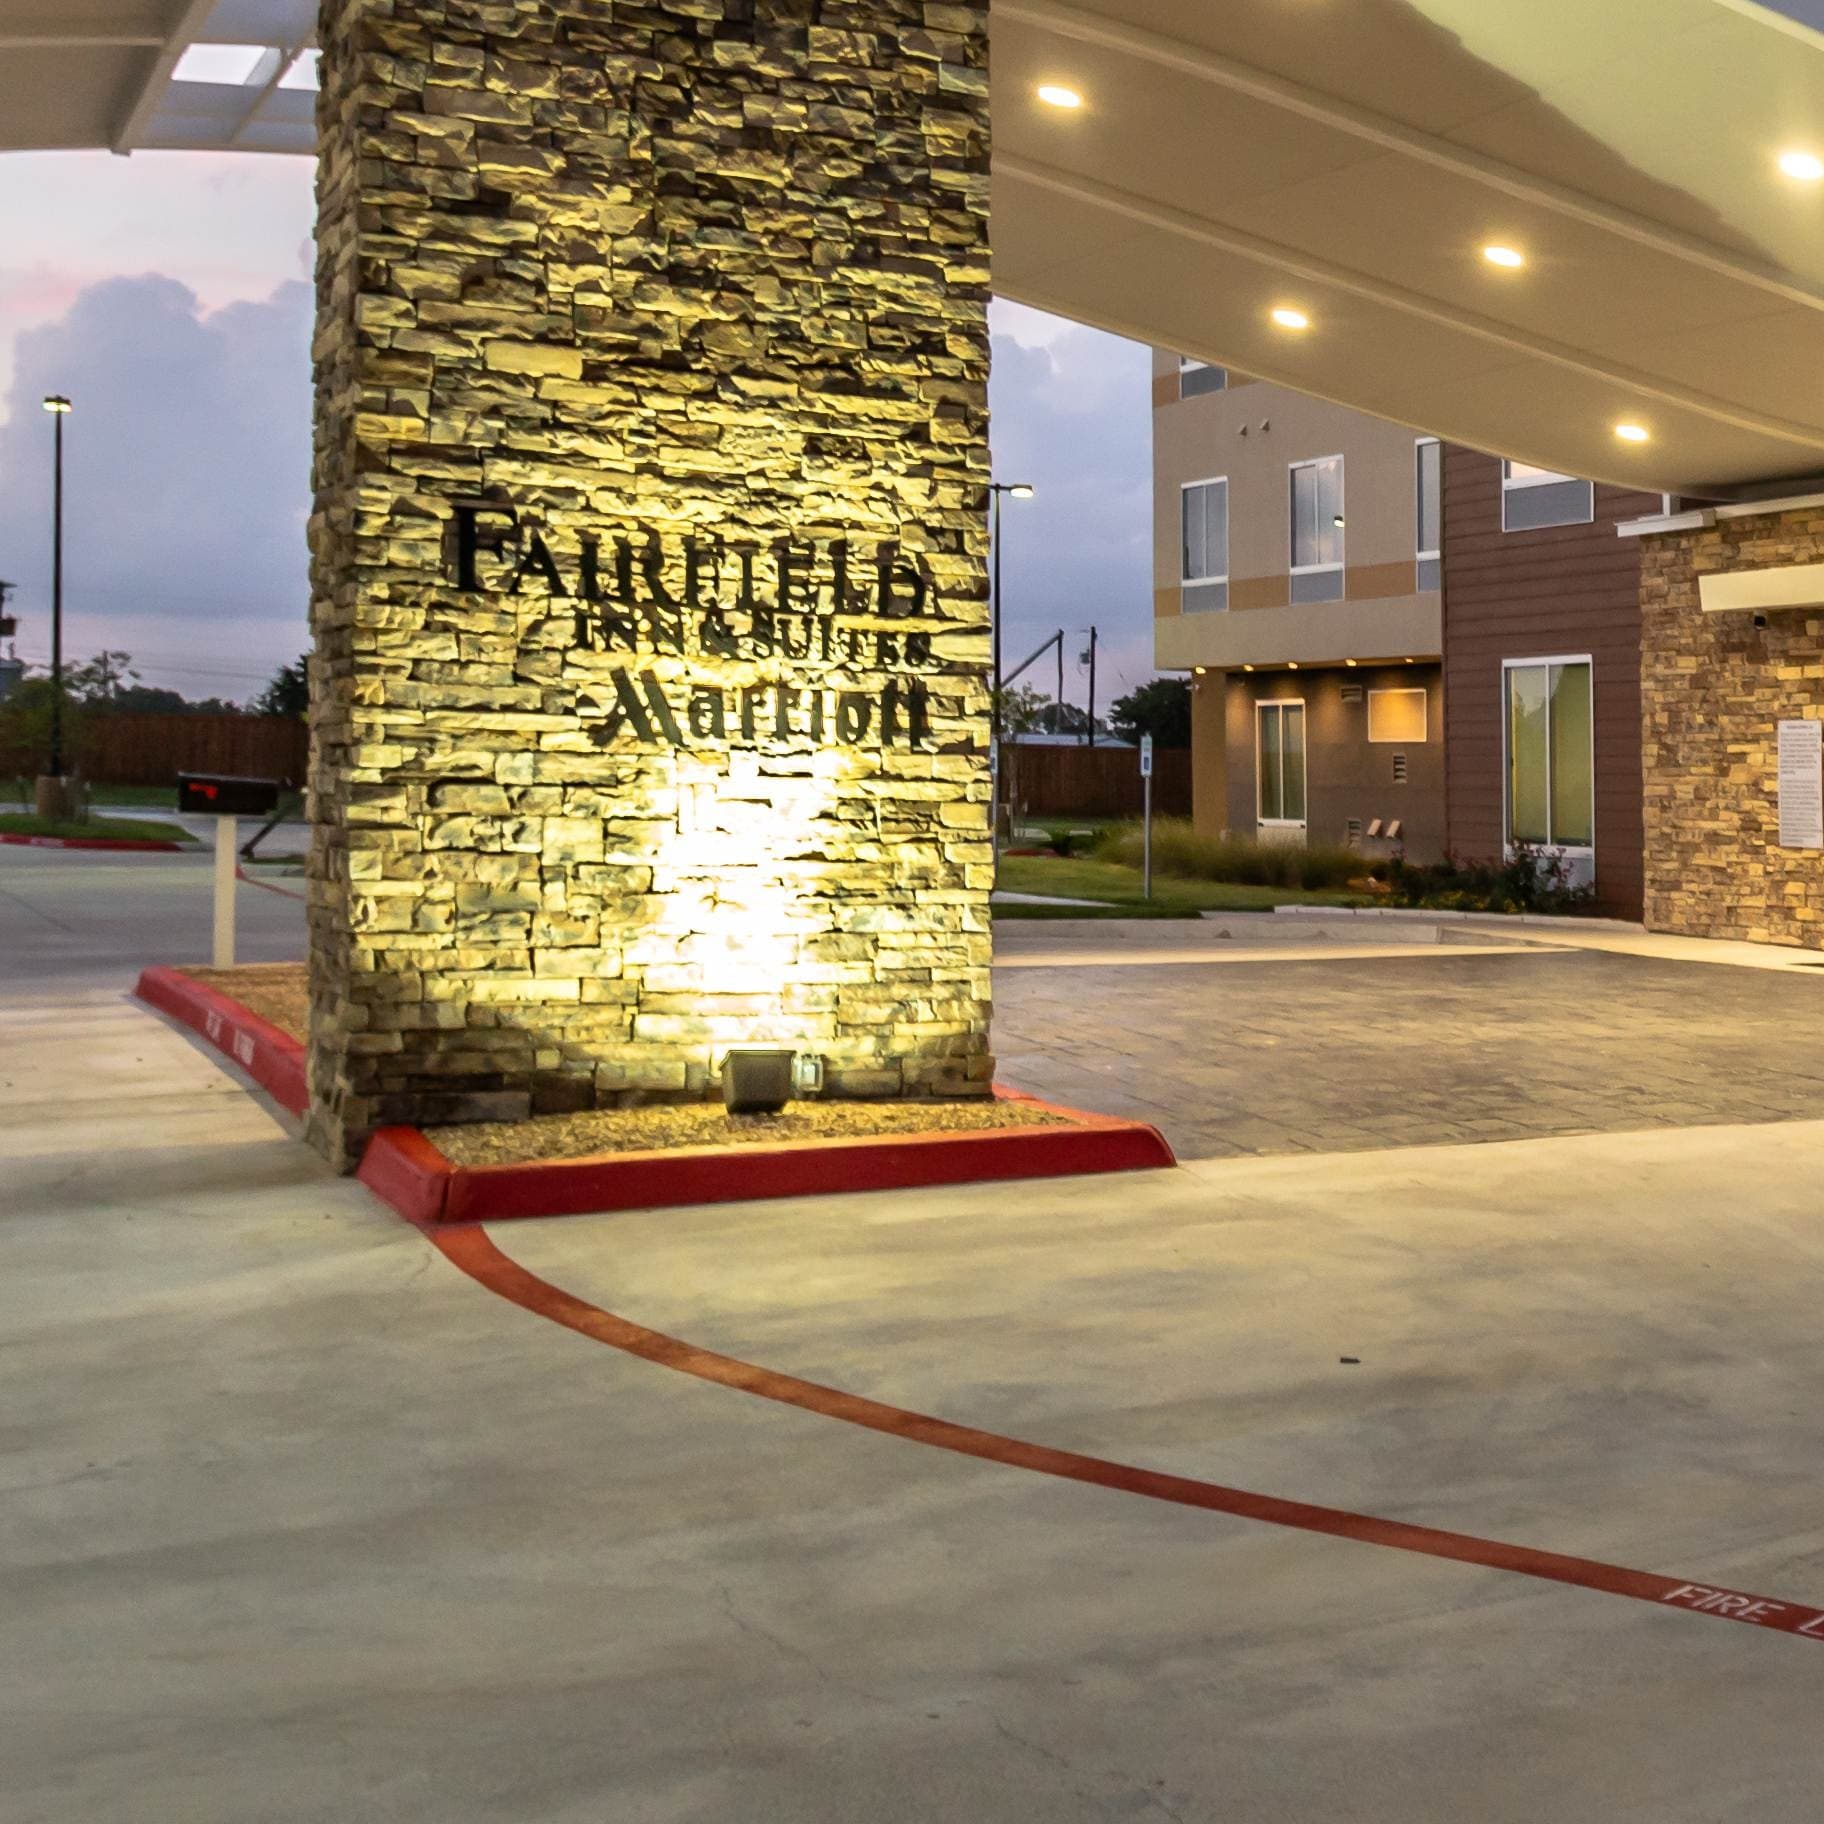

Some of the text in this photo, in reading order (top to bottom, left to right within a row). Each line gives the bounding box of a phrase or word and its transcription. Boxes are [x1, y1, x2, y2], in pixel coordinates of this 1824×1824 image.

[455, 508, 927, 618] FAIRFIELD
[573, 604, 684, 654] INN
[749, 606, 932, 668] SUITES
[587, 664, 932, 754] Marriott
[1664, 1584, 1786, 1622] FIRE
